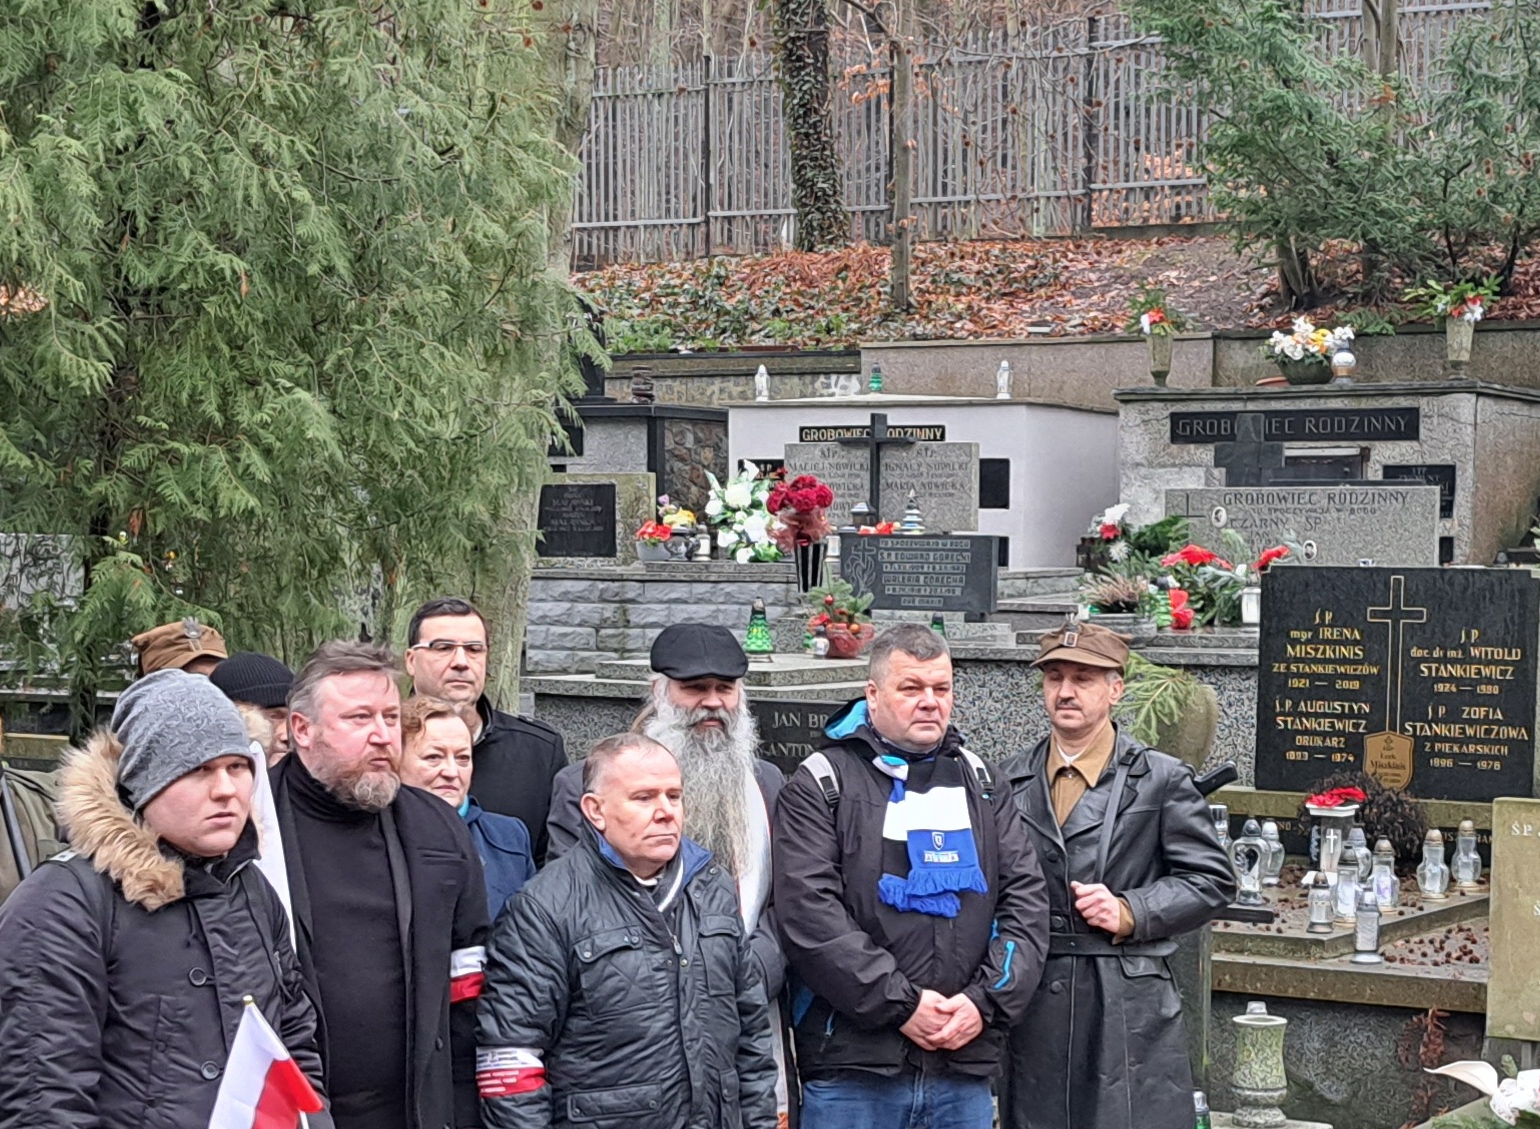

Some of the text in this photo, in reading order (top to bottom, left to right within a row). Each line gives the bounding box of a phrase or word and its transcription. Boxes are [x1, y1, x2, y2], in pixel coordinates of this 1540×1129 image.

[1176, 415, 1409, 436] GROBIEC RODZINNY
[886, 427, 943, 441] ODZINNY
[829, 482, 864, 492] OWICKA
[1222, 491, 1409, 506] GROBOWIEC RODZINNY
[1290, 627, 1361, 642] mgr IRENA
[1286, 643, 1364, 660] MISZKINIS
[1470, 646, 1522, 661] WITOLD
[1272, 662, 1380, 676] ZE STANKIEWICZÓW
[1419, 663, 1515, 680] STANKIEWICZ
[1297, 700, 1371, 714] AUGUSTYN
[1461, 707, 1504, 721] ZOFIA
[772, 711, 801, 729] JAN
[1276, 716, 1368, 733] STANKIEWICZ
[1404, 722, 1530, 741] STANKIEWICZOWA
[1434, 743, 1508, 757] PIEKARSKICH
